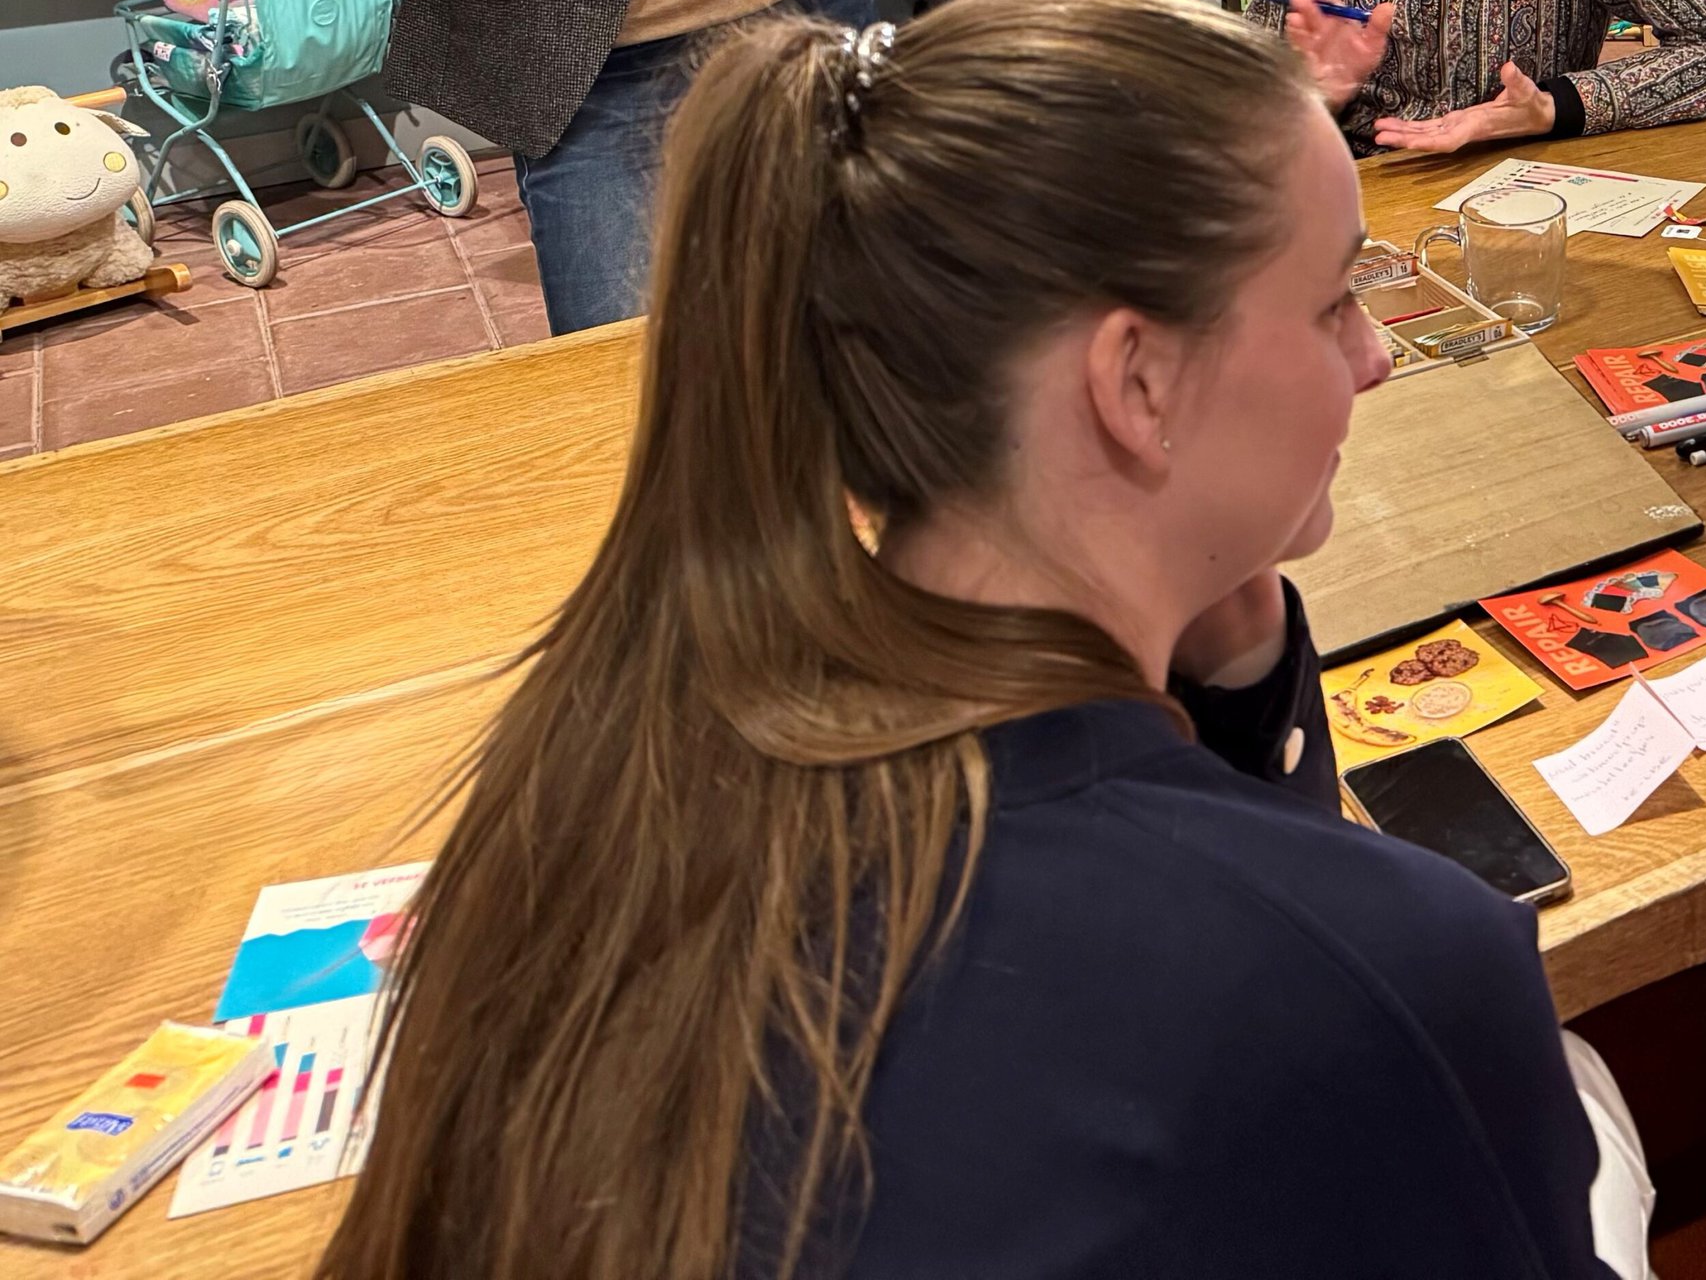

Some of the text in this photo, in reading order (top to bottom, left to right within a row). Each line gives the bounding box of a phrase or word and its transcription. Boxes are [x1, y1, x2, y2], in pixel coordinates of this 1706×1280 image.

[1354, 269, 1390, 285] BRADLEY'S
[1444, 334, 1482, 350] BRADLEY'S
[1603, 354, 1660, 404] REPAIR
[1502, 604, 1599, 676] REPAIR
